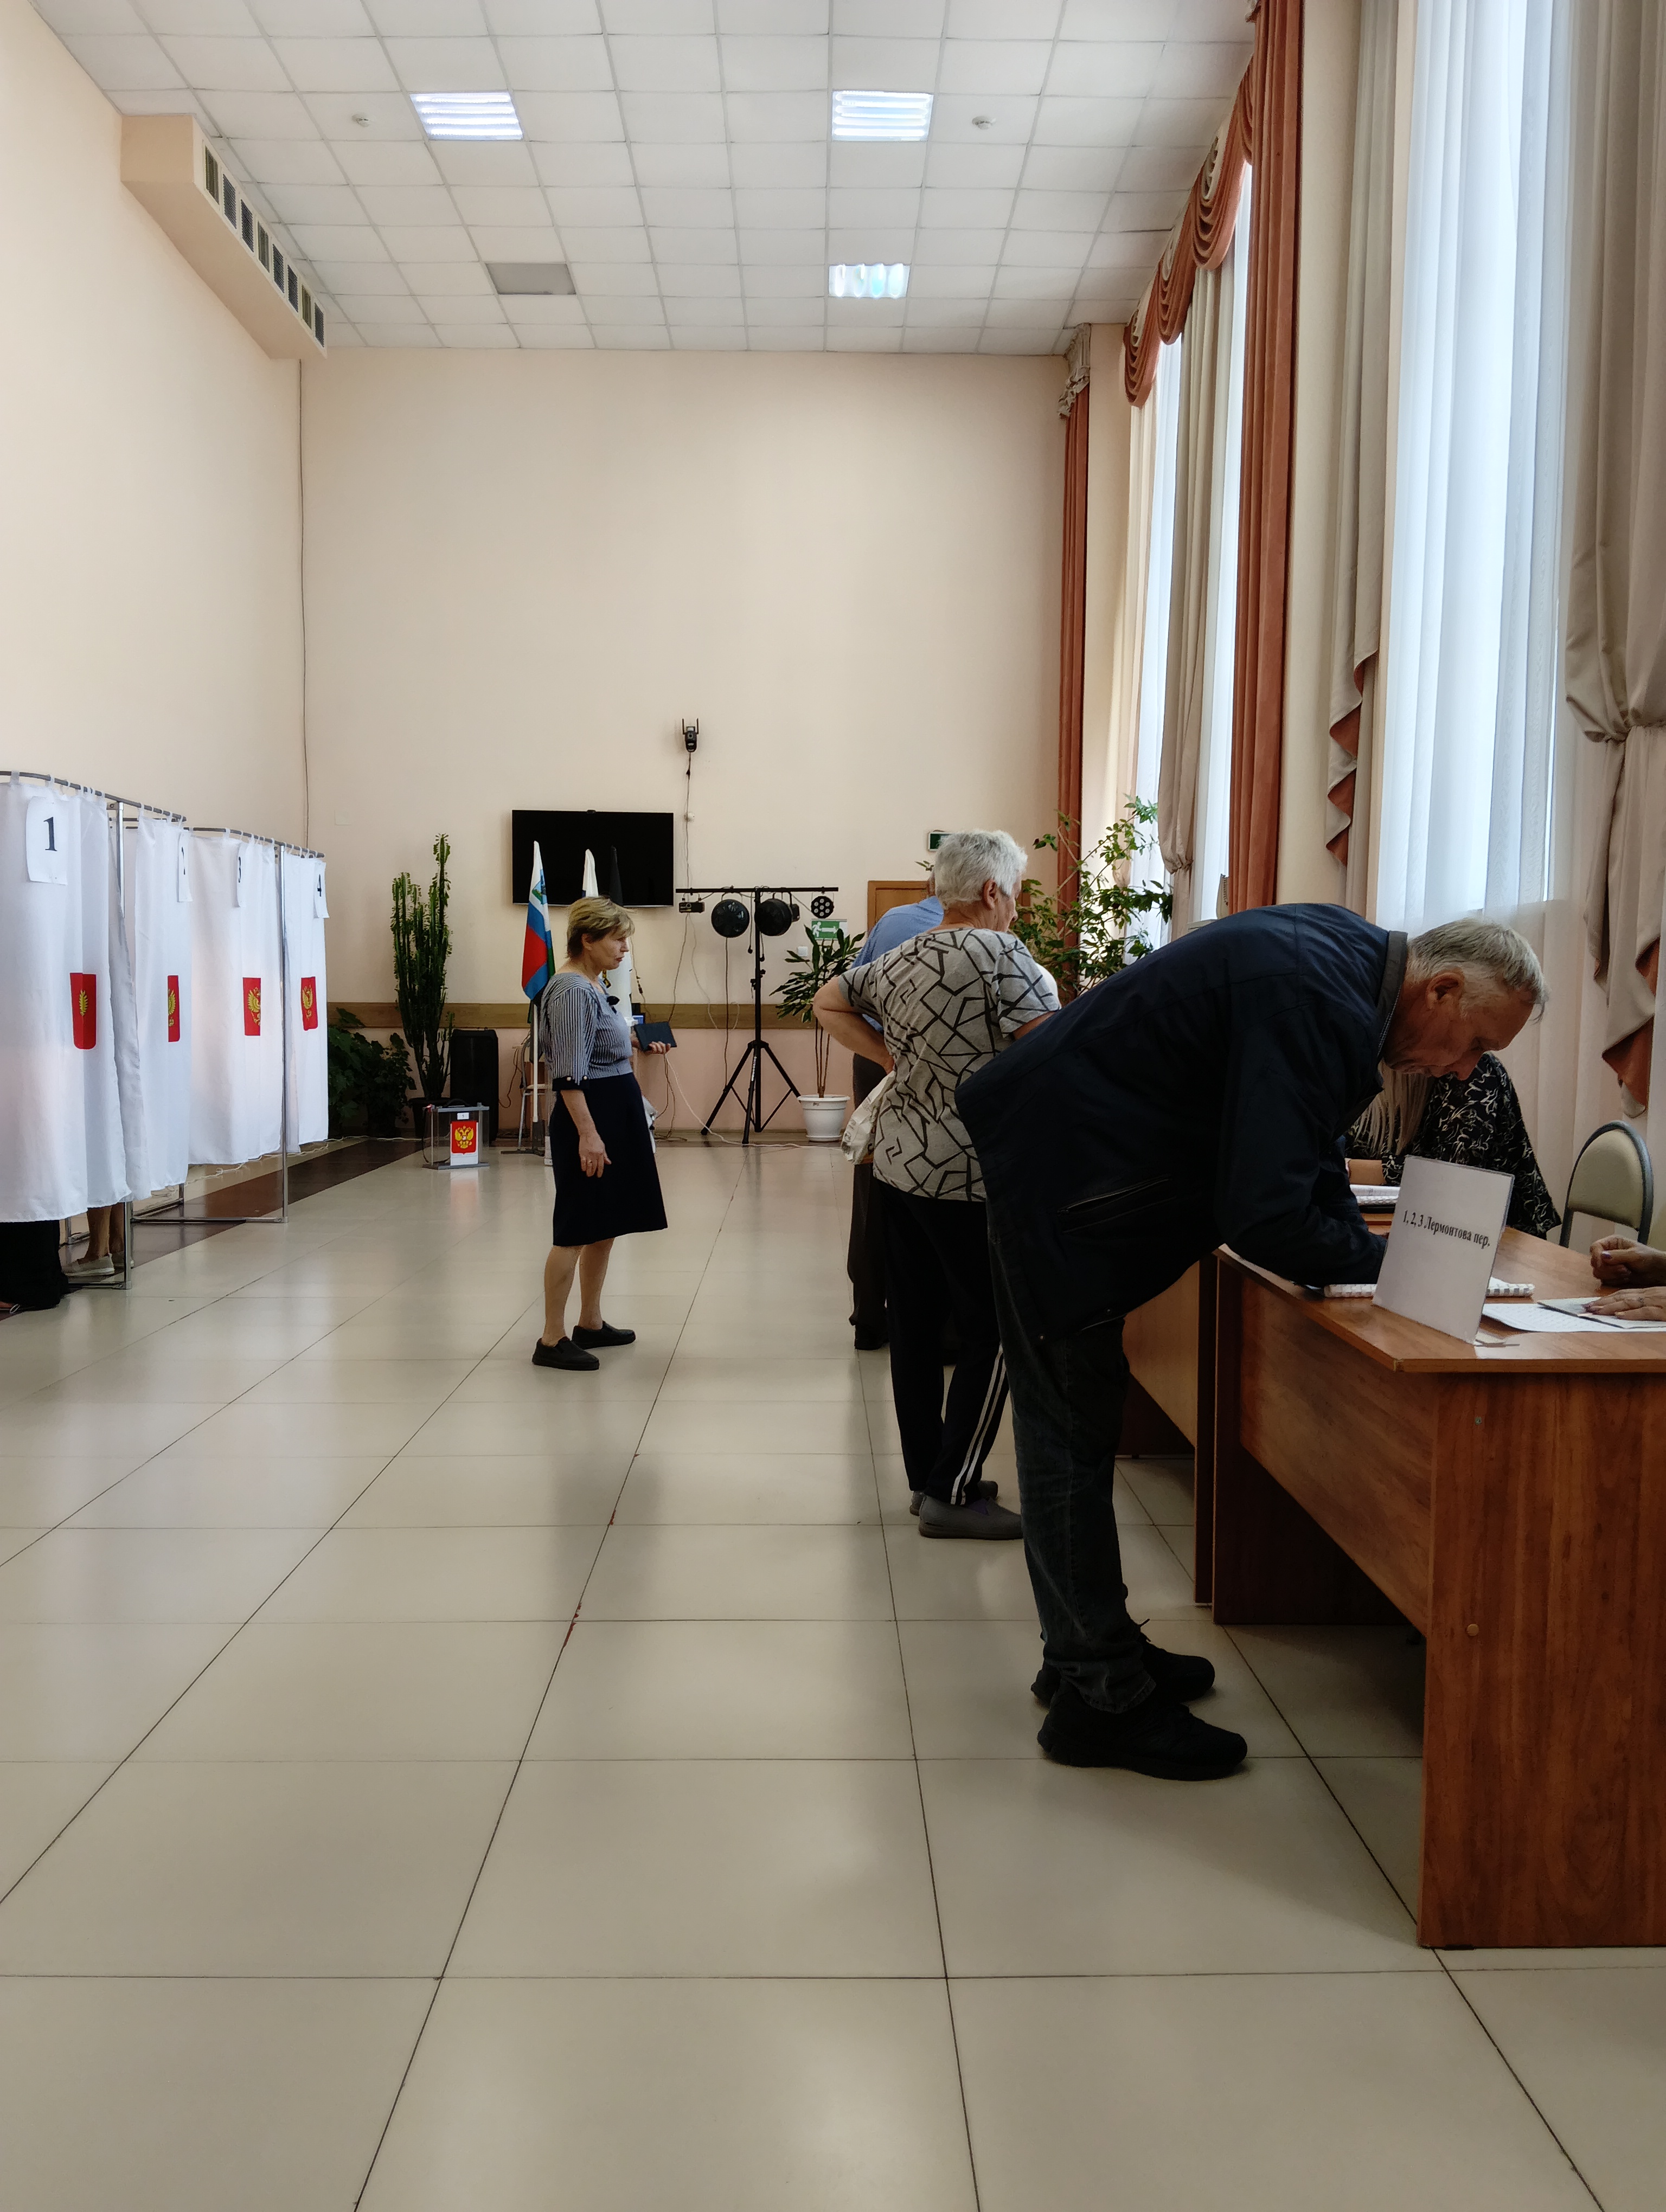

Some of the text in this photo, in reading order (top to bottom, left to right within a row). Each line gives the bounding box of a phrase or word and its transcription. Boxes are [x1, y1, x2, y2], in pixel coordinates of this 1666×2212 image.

[43, 816, 57, 851] 1
[317, 873, 322, 897] 4
[1403, 1210, 1490, 1249] 1, 2, 3 Лермонтова пер.
